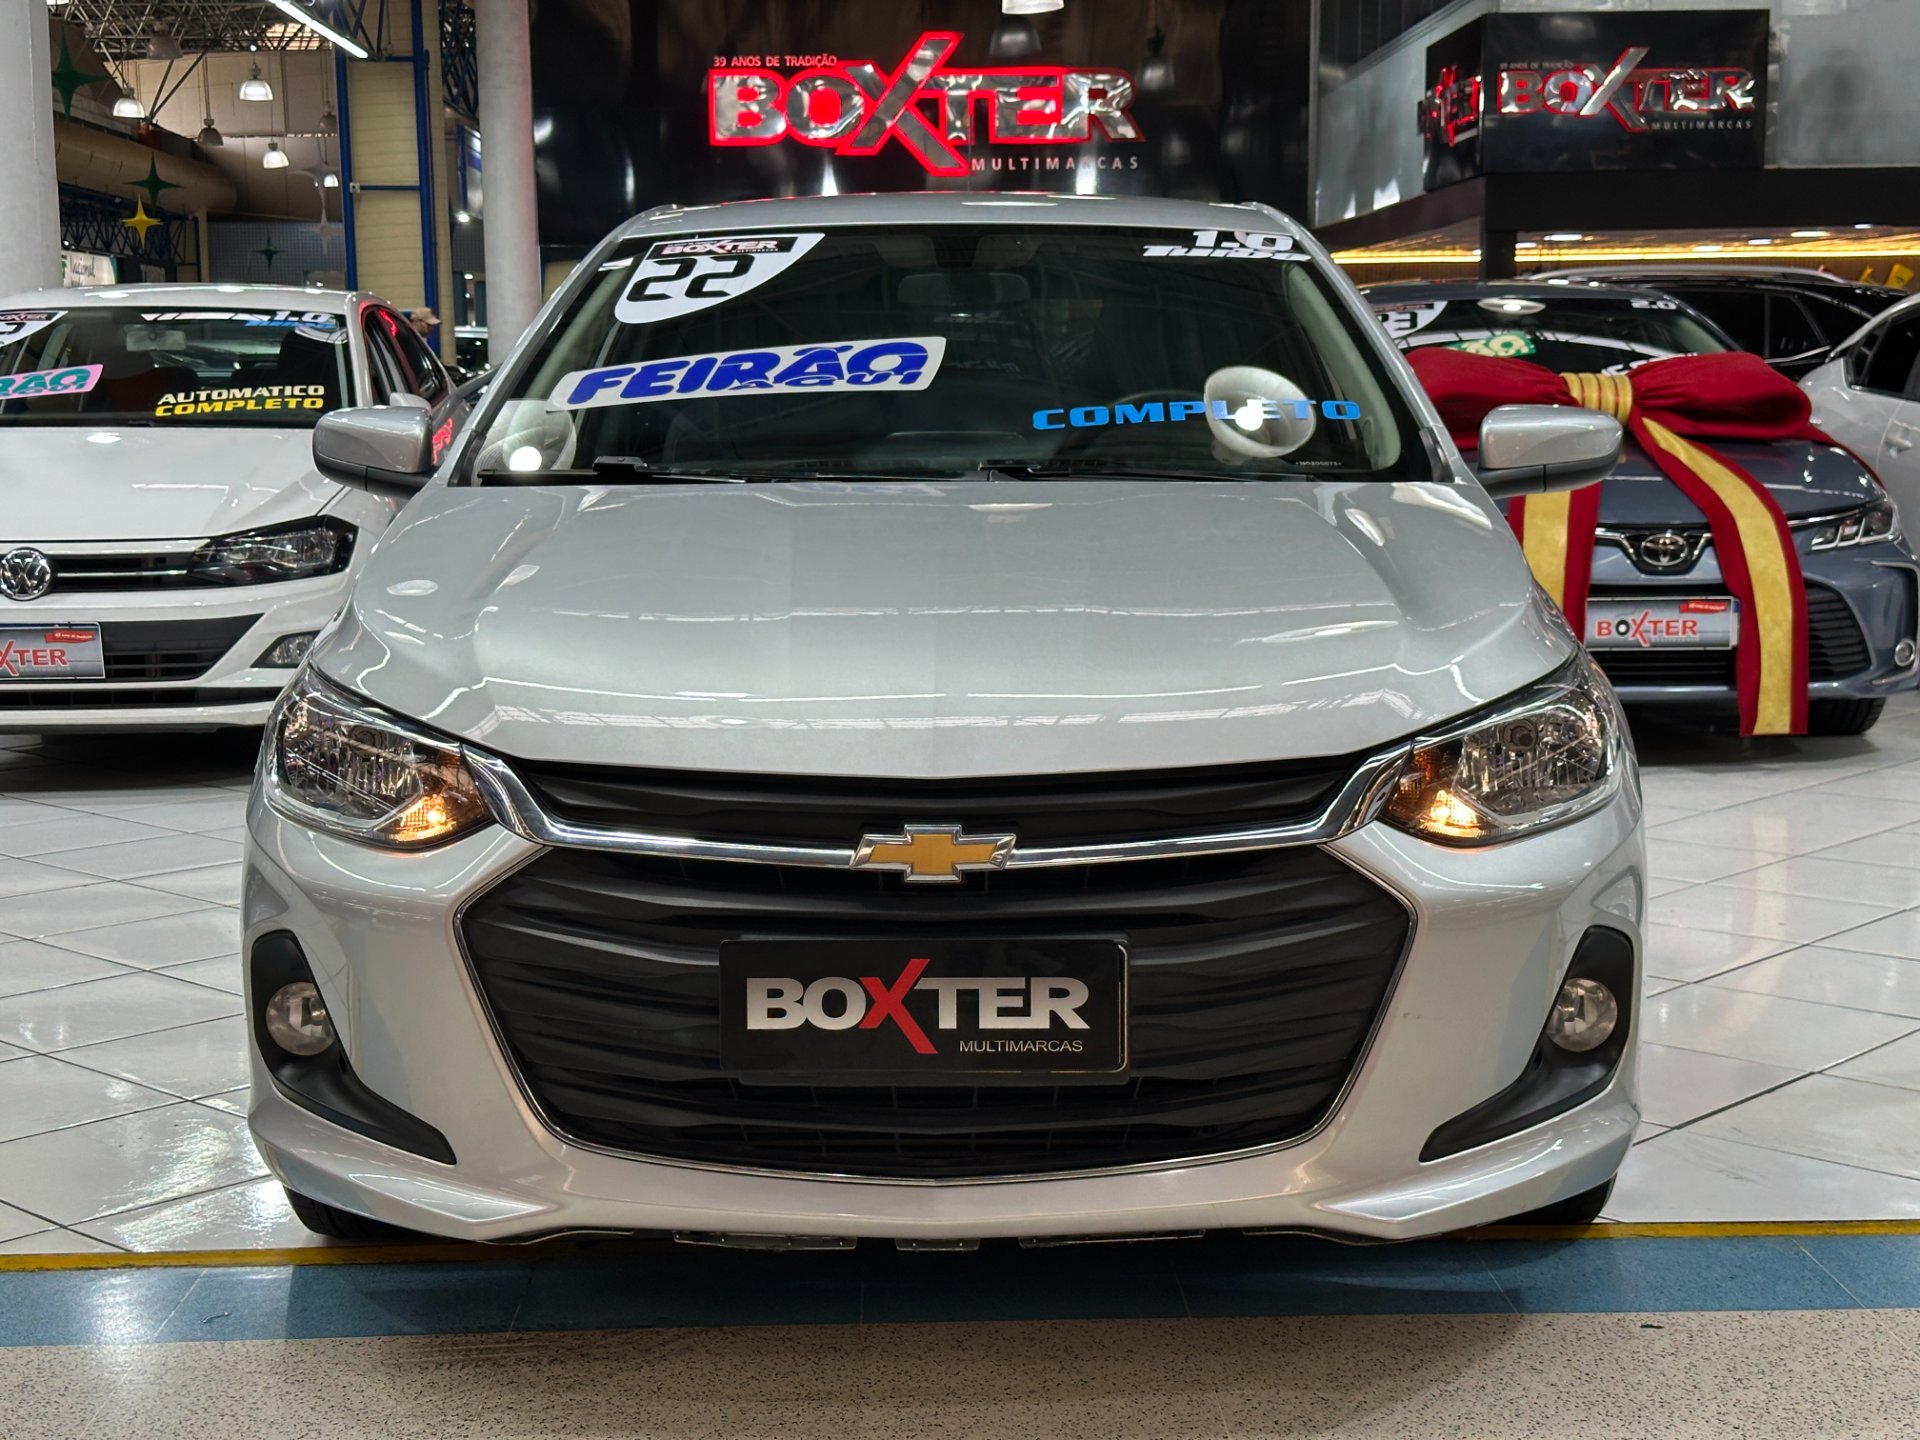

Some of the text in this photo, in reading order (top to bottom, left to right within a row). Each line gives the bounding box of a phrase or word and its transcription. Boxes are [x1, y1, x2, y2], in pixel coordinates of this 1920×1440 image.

[713, 53, 837, 68] 39 ANOS DE TRADIÇÃO
[1497, 47, 1756, 133] BOXTER
[709, 31, 1146, 176] BOXTER
[1651, 119, 1752, 130] MULTIMARCAS
[972, 155, 1138, 171] MULTIMARCAS
[661, 240, 778, 255] BOXTER
[1193, 231, 1293, 251] 1.0
[626, 255, 756, 301] 22
[567, 342, 928, 404] FEIRÃO
[157, 385, 325, 405] AUTOMATICO
[155, 398, 324, 417] COMPLETO
[1033, 399, 1361, 431] COMPLETO
[1596, 609, 1698, 647] BOXTER
[746, 958, 1090, 1055] BOXTER
[959, 1040, 1083, 1053] MULTIMARCAS
